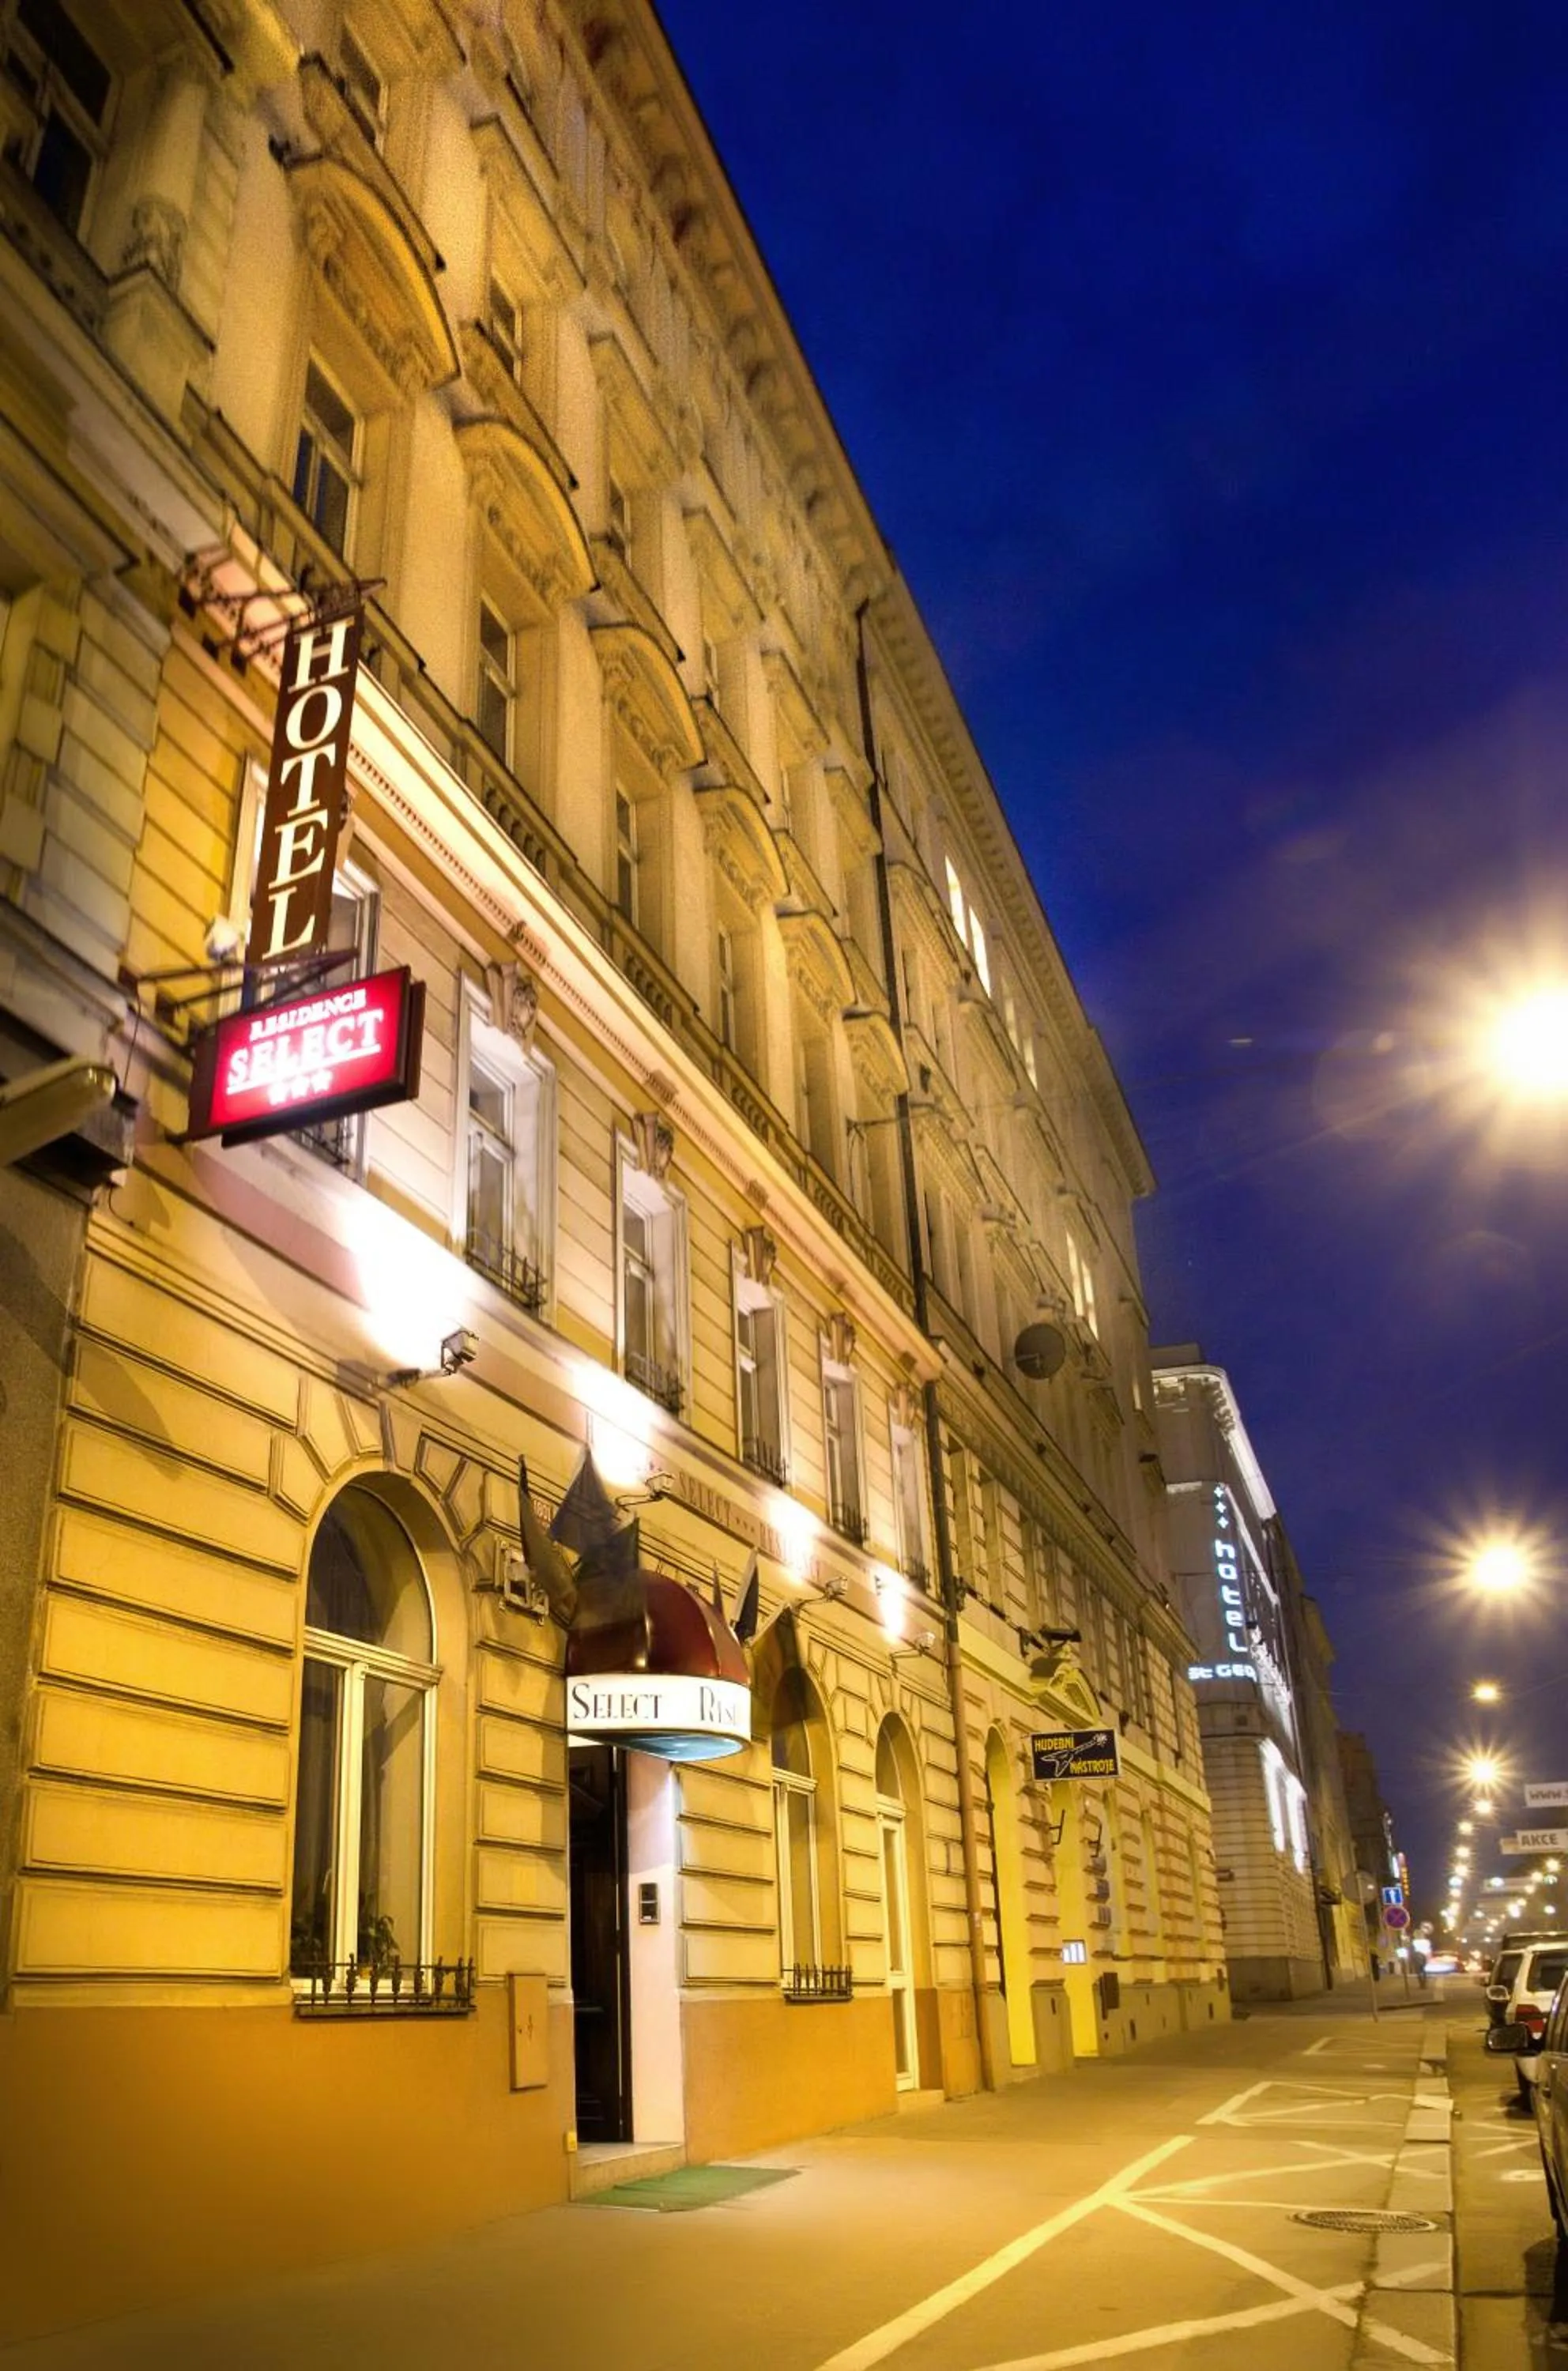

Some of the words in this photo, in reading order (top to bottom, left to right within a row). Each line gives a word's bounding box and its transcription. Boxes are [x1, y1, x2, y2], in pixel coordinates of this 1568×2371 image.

[262, 615, 356, 961] HOTEL
[226, 1008, 384, 1087] SELECT
[679, 1470, 731, 1528] SELECT
[1521, 1834, 1559, 1846] AKCE
